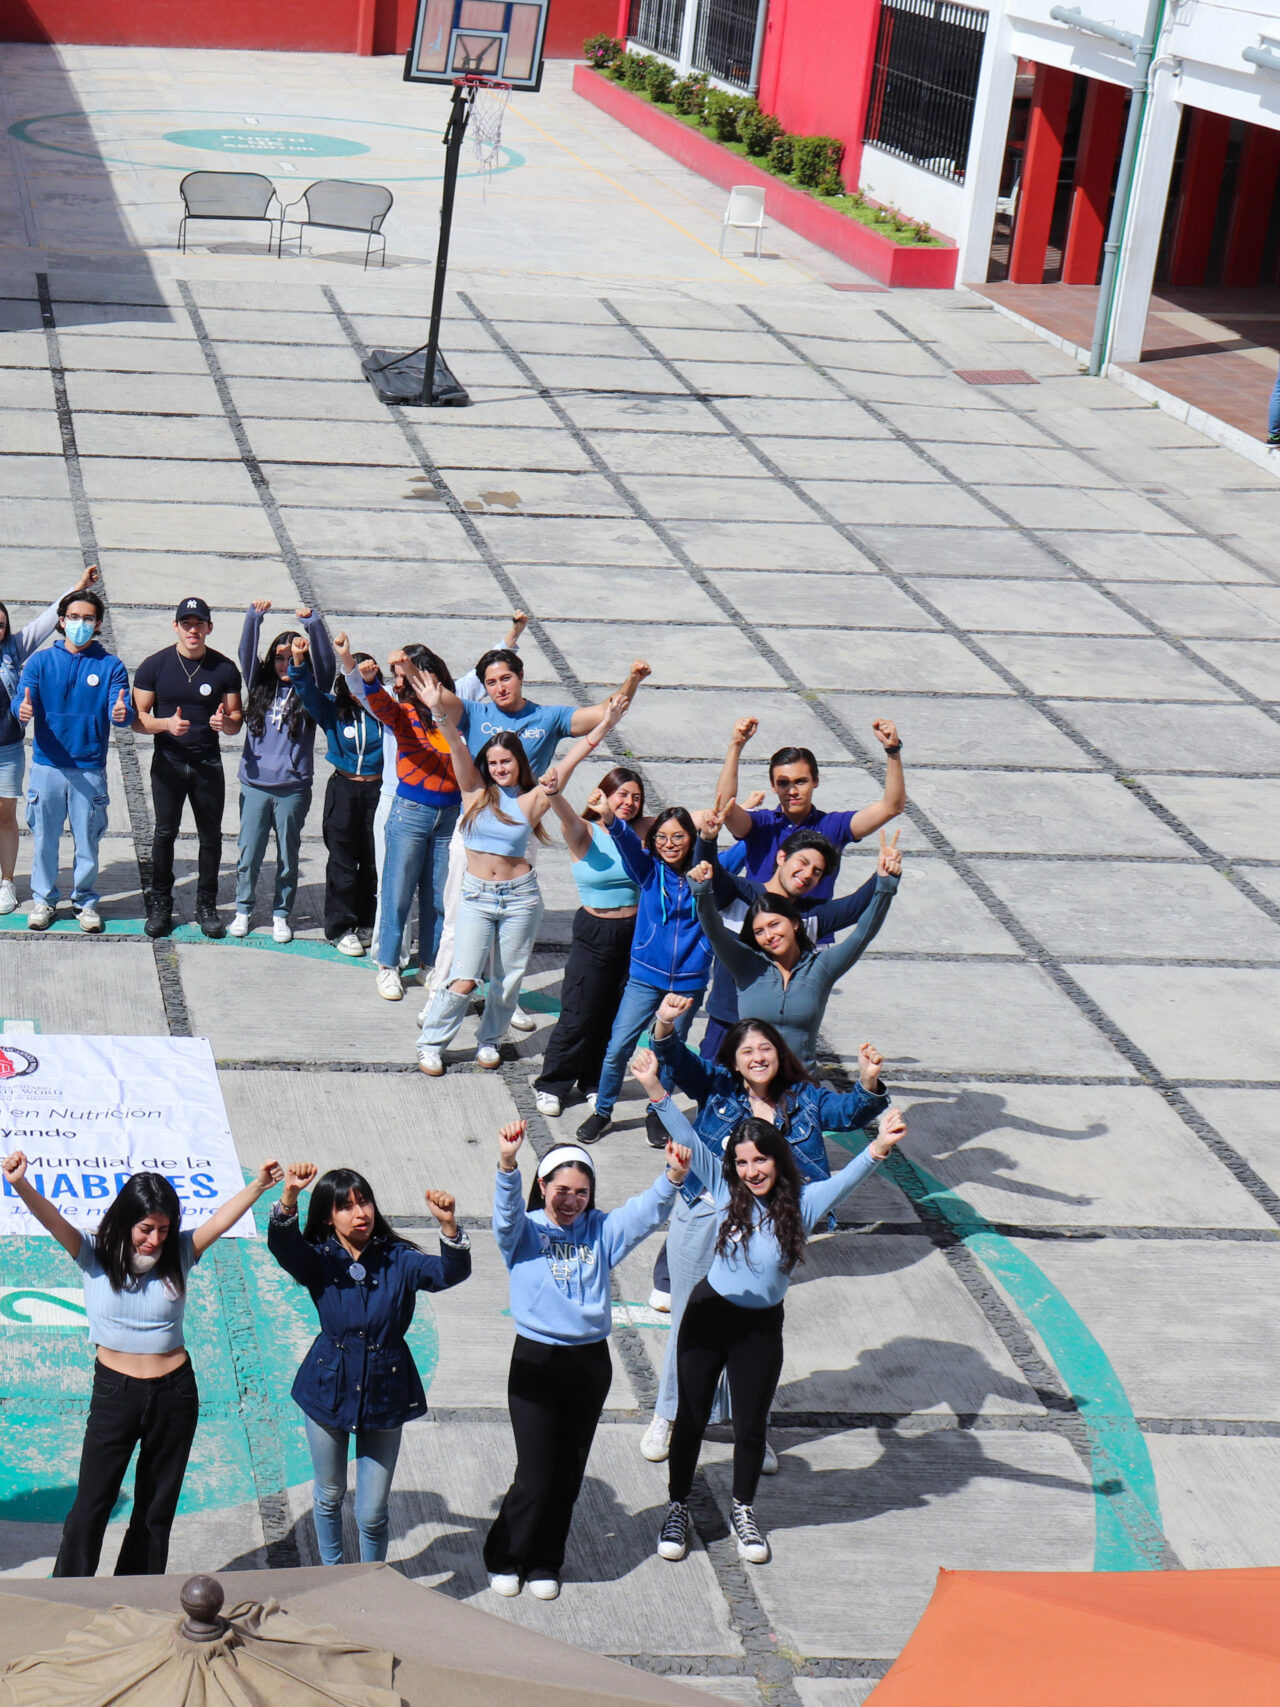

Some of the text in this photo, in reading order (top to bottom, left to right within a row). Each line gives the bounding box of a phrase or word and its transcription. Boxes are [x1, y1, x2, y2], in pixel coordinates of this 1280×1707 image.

[10, 1108, 40, 1119] en
[49, 1107, 163, 1121] Nutrición
[141, 1157, 178, 1169] de
[186, 1156, 212, 1169] la
